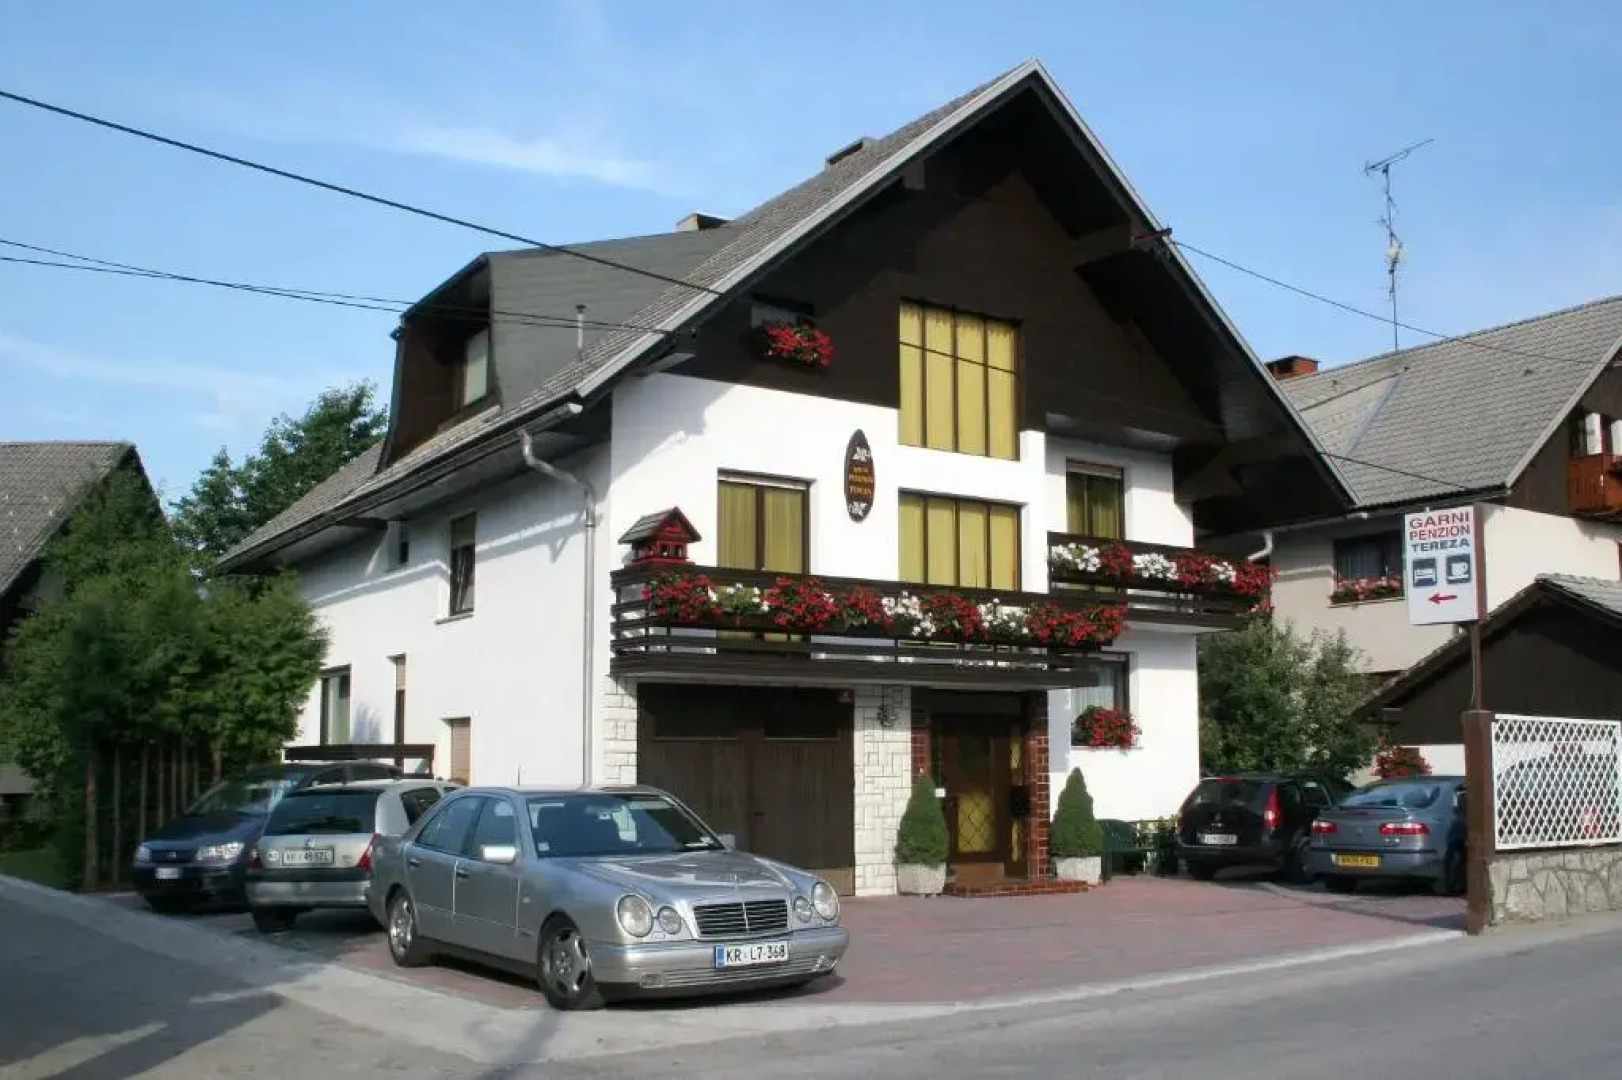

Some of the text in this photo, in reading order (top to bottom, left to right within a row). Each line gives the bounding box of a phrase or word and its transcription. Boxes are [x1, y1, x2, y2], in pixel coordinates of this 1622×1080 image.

[1409, 511, 1470, 530] GARNI
[1409, 524, 1471, 541] PENZION
[1411, 537, 1471, 552] TEREZA
[726, 948, 742, 963] KR
